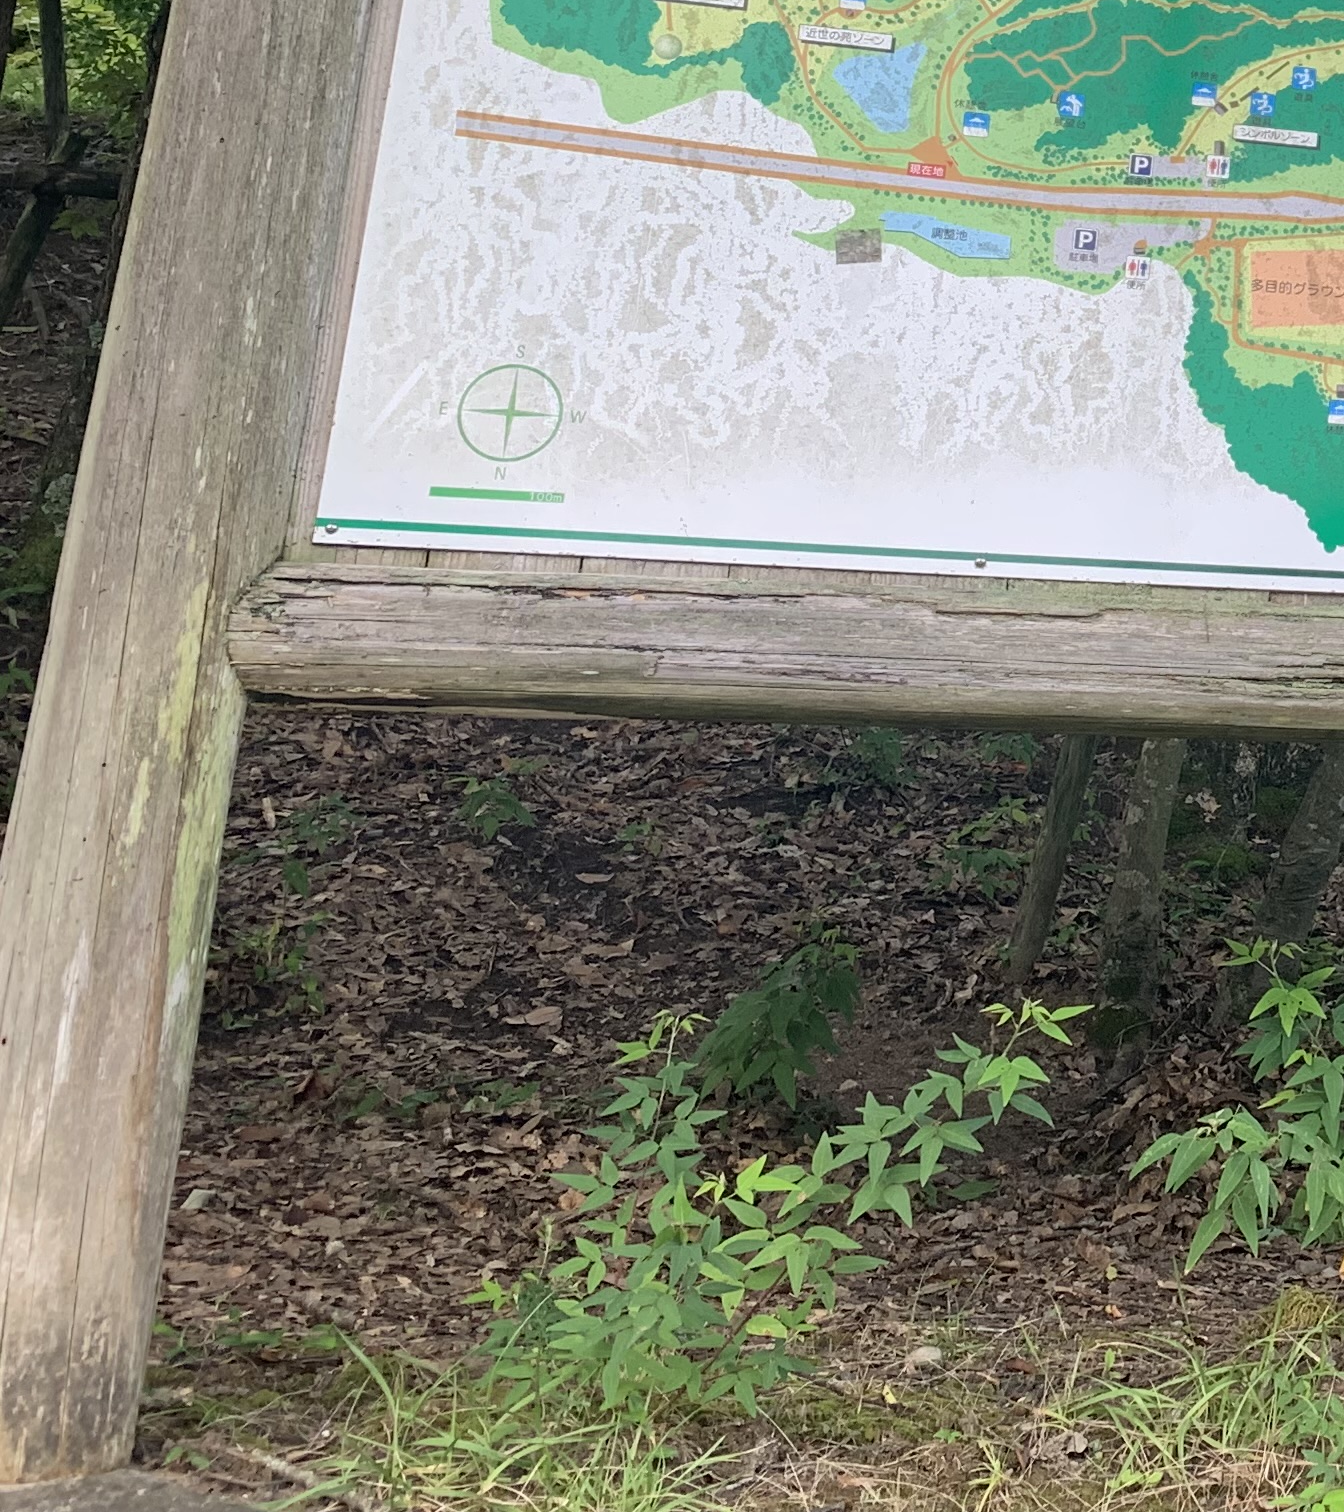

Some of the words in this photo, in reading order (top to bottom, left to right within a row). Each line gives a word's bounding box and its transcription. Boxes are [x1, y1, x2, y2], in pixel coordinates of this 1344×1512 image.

[909, 163, 945, 177] 現在地
[515, 345, 526, 359] S
[439, 400, 449, 416] E
[570, 409, 587, 424] W
[494, 467, 507, 481] N
[529, 492, 564, 503] 100m
